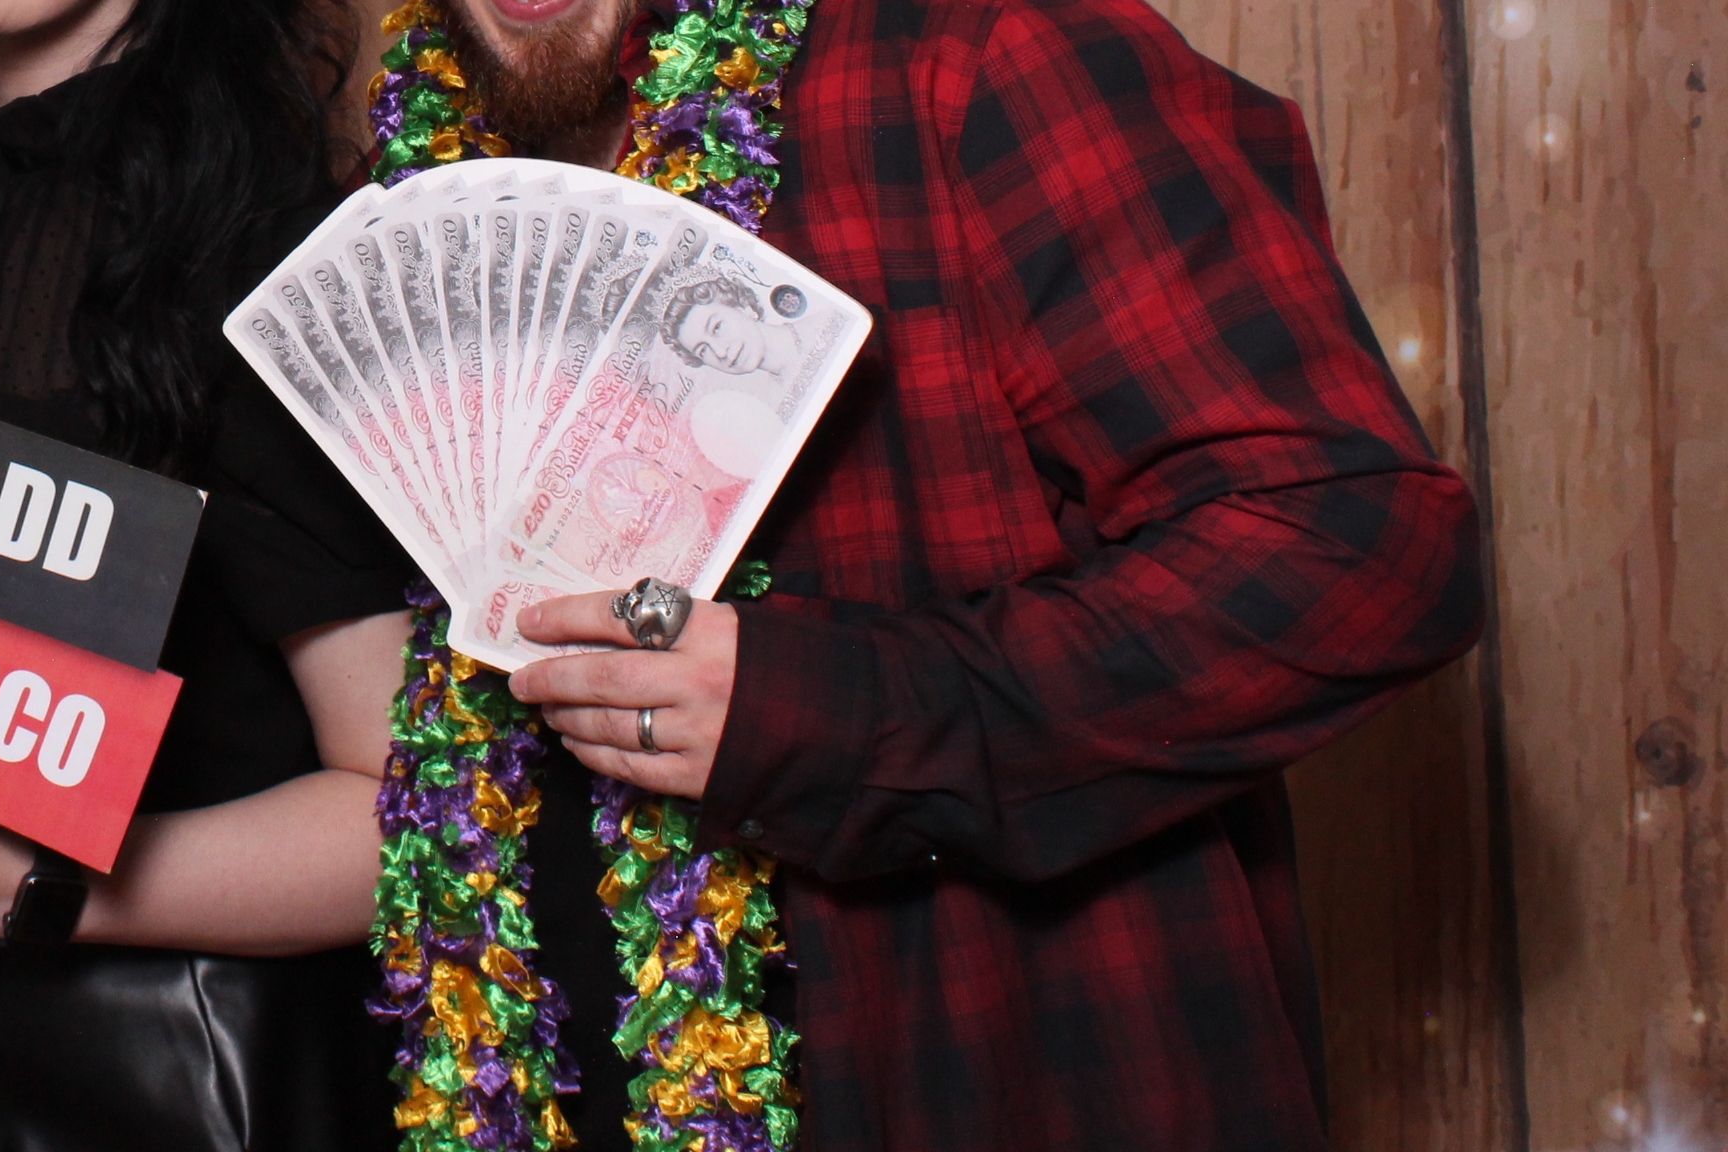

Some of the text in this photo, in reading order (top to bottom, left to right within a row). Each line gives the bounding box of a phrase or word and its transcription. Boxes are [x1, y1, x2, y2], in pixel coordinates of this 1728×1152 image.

[535, 431, 590, 498] Bank
[586, 339, 642, 419] England
[612, 375, 656, 445] FIFTY
[639, 372, 694, 454] Pounds
[524, 493, 551, 540] £50
[486, 592, 509, 641] £50
